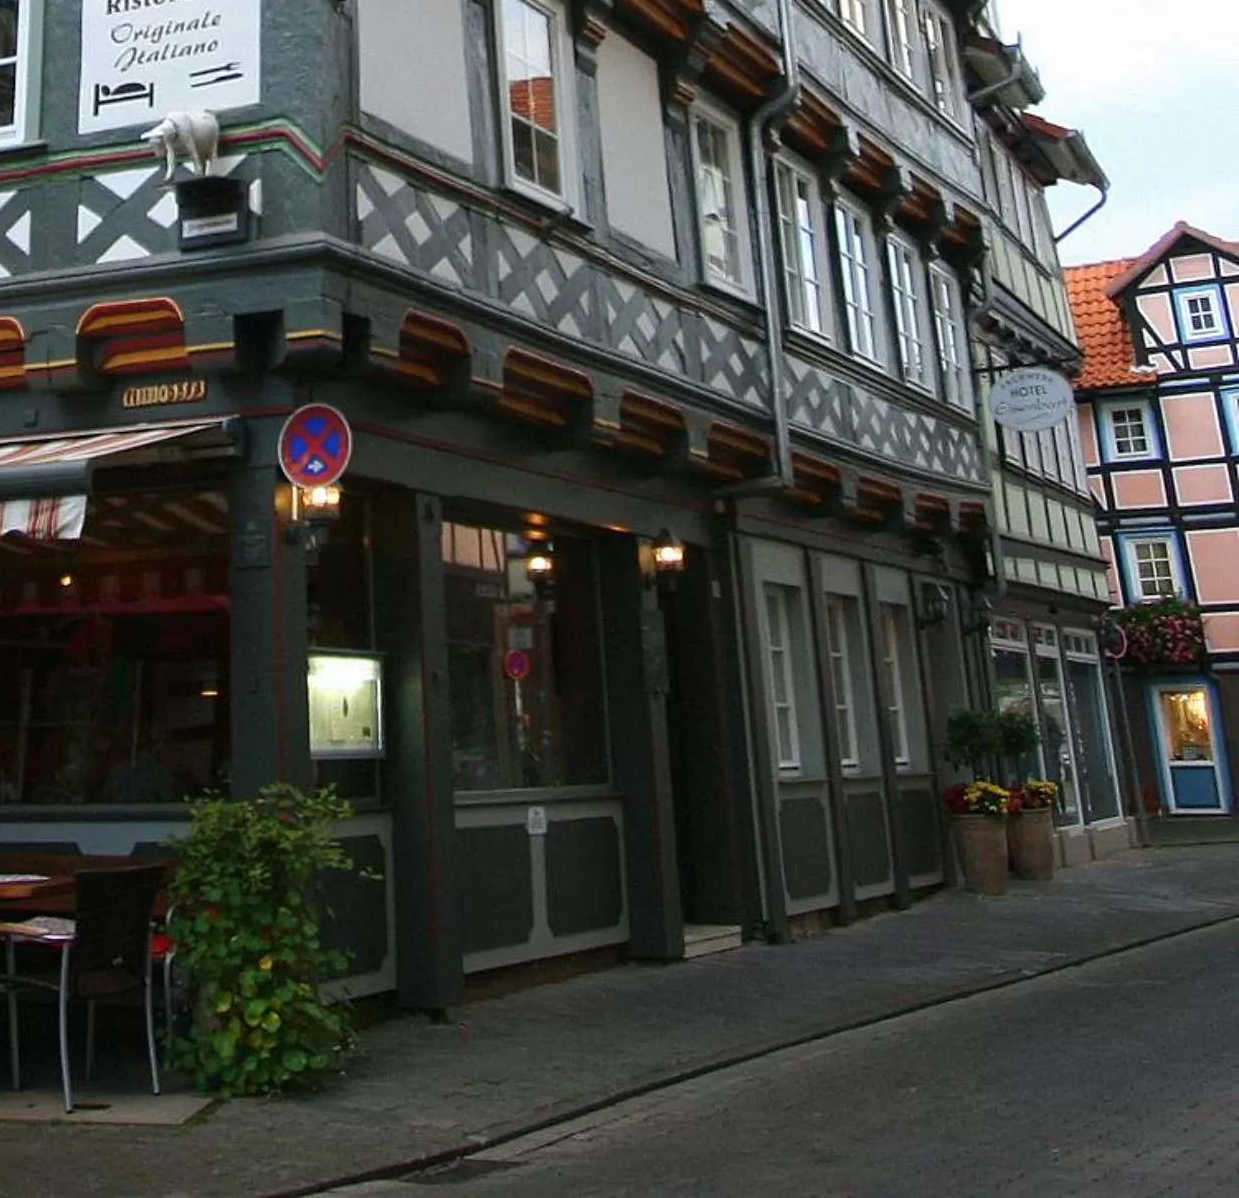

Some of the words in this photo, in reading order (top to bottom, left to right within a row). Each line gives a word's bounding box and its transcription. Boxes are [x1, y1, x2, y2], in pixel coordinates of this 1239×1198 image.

[110, 12, 222, 45] Originale
[113, 38, 219, 72] Italiano
[1009, 384, 1049, 399] HOTEL
